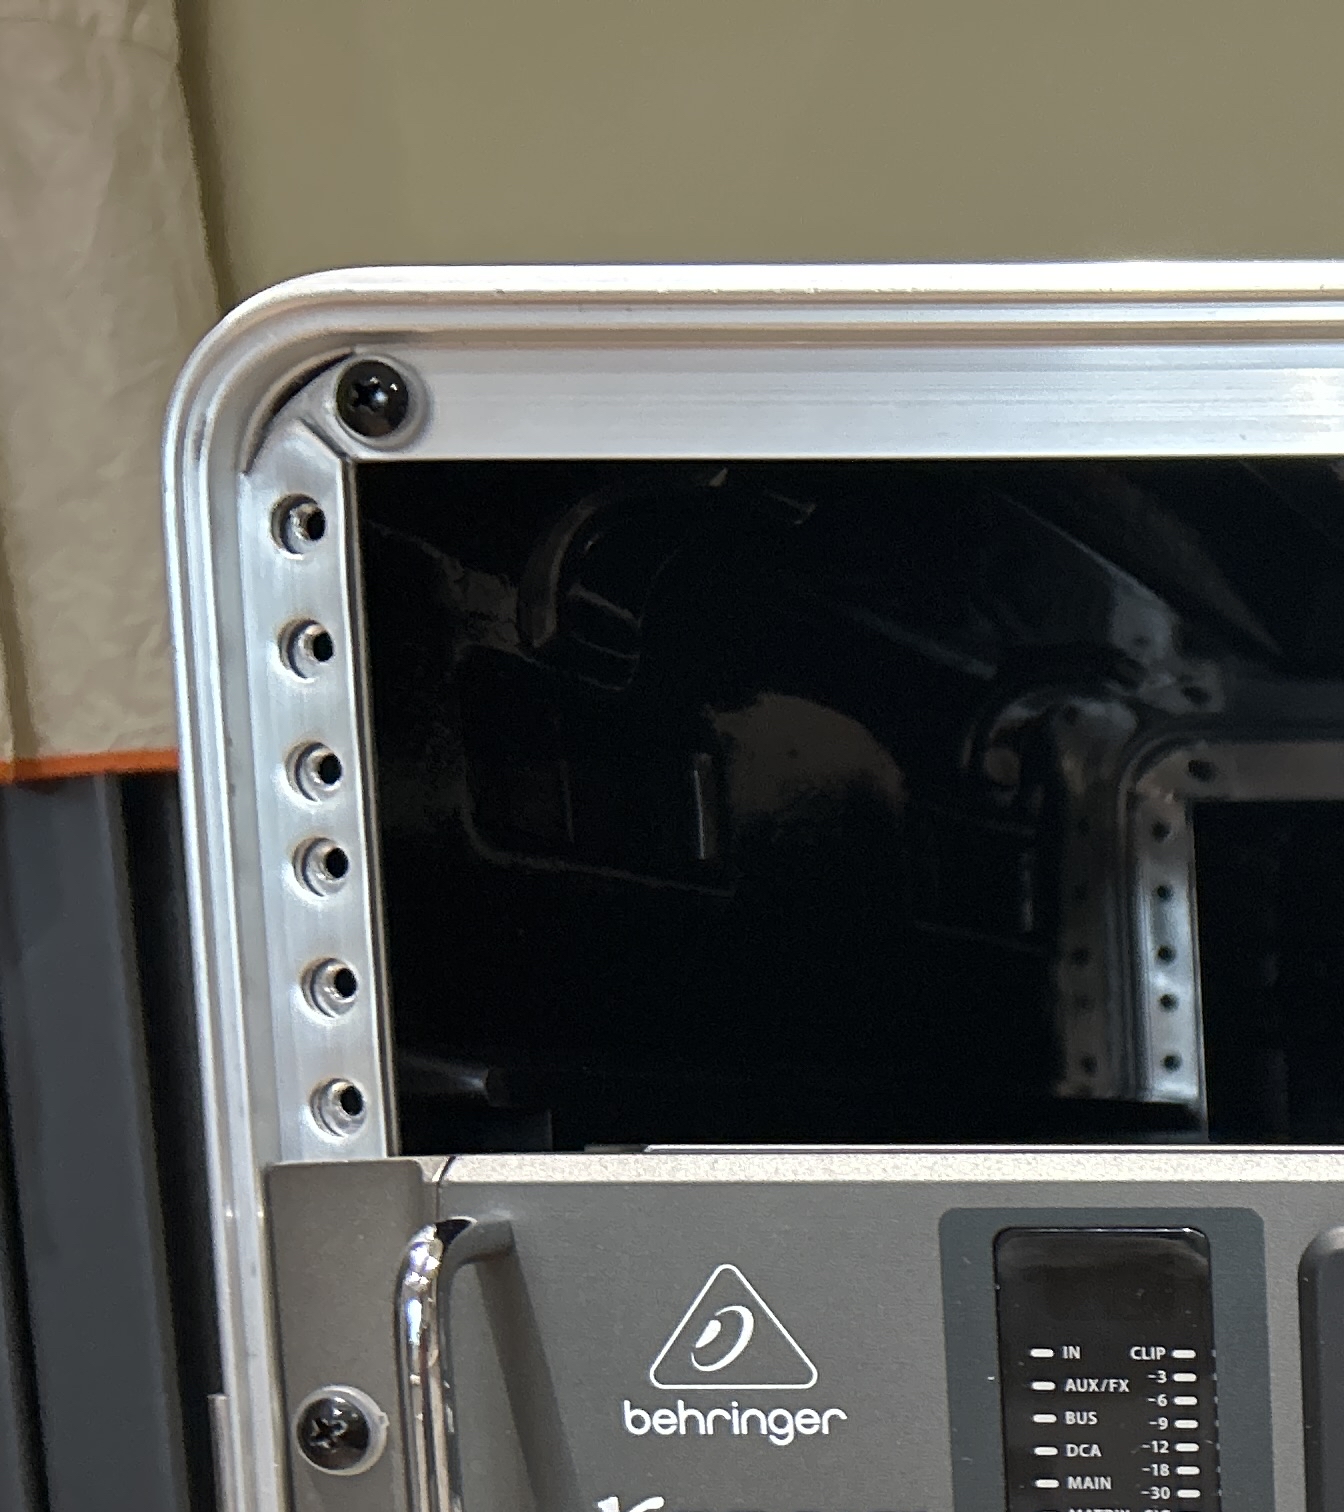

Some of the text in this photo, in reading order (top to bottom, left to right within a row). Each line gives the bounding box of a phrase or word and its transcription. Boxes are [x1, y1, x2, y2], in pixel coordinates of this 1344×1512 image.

[1063, 1346, 1080, 1359] IN
[1130, 1347, 1165, 1360] CLIP
[1148, 1370, 1167, 1383] -3
[1065, 1379, 1129, 1392] AUX/FX
[1148, 1394, 1167, 1406] -6
[624, 1400, 847, 1445] behringer
[1065, 1411, 1097, 1424] BUS
[1150, 1417, 1168, 1430] -9
[1067, 1444, 1101, 1457] DCA
[1143, 1441, 1169, 1453] -12
[1142, 1464, 1169, 1476] -18
[1068, 1477, 1111, 1489] MAIN
[1142, 1487, 1170, 1499] -30
